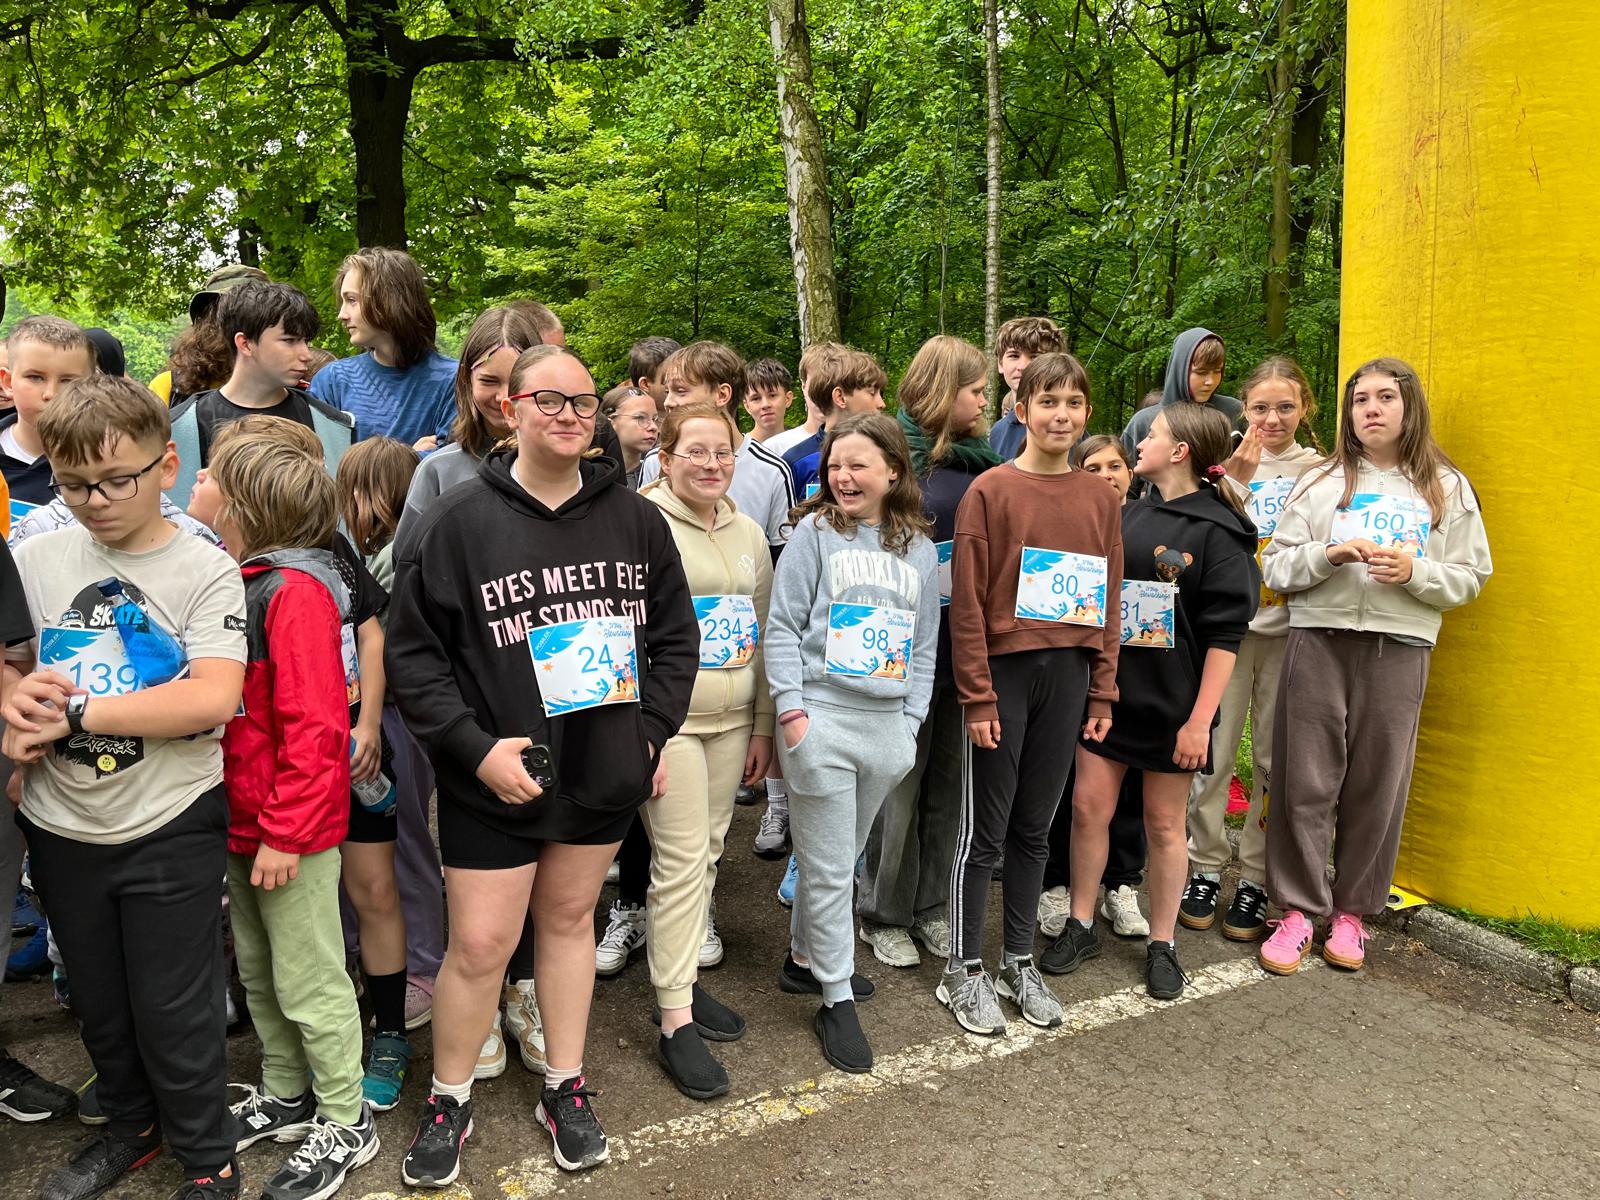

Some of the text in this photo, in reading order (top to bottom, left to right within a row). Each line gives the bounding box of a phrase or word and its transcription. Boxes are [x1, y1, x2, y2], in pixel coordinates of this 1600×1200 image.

[1361, 510, 1405, 531] 160
[480, 561, 649, 611] EYES MEET EYE
[1051, 573, 1078, 597] 80
[90, 602, 144, 626] SKATE
[488, 598, 647, 648] TIME STANDS STIL
[704, 617, 742, 642] 234
[862, 627, 889, 652] 98
[577, 644, 614, 673] 24
[69, 661, 140, 695] 139
